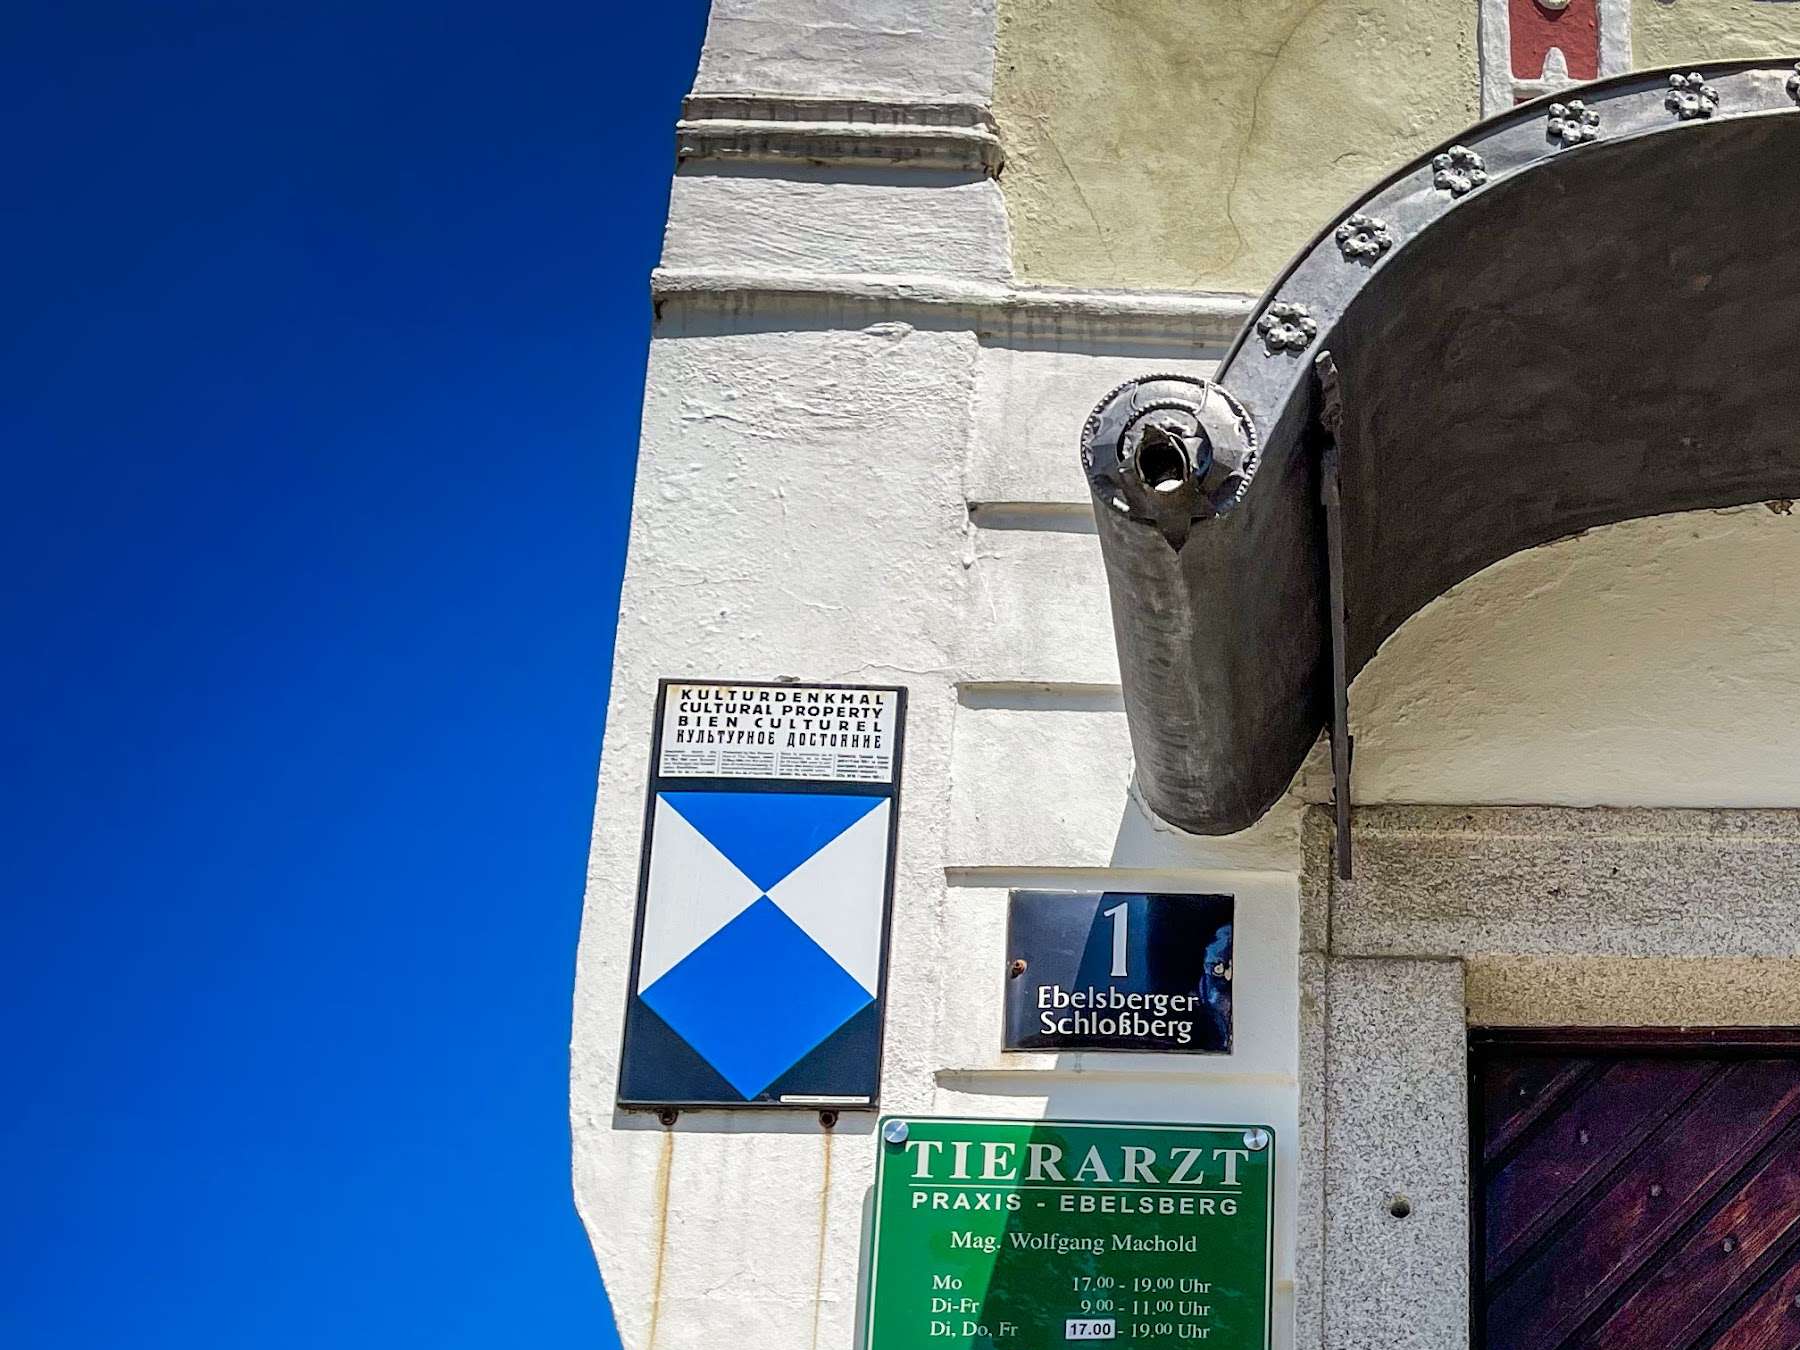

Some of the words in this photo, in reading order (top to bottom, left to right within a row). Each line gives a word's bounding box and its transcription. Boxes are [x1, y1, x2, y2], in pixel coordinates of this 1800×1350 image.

[681, 689, 884, 705] KULTURDENKMAL
[680, 703, 773, 715] CULTURAL
[782, 706, 883, 719] PROPERTY
[678, 716, 738, 727] BIEN
[754, 718, 882, 732] CULTUREL
[677, 730, 776, 745] КУЛЬТУРНОЕ
[786, 733, 882, 748] ДОСТОЯНИЕ
[1103, 902, 1128, 977] 1
[1038, 985, 1199, 1016] Ebelsberger
[1040, 1011, 1193, 1043] Schloßberg
[906, 1140, 1249, 1186] TIERARZT
[912, 1191, 1022, 1211] PRAXIS
[1059, 1195, 1238, 1215] EBELSBERG
[950, 1231, 1001, 1253] Mag.
[1011, 1233, 1105, 1254] Wolfgang
[1112, 1235, 1197, 1252] Machold
[933, 1275, 962, 1290] Mo
[1073, 1276, 1114, 1293] 17.00
[1133, 1278, 1174, 1293] 19.00
[1179, 1279, 1212, 1294] Uhr
[931, 1298, 980, 1314] Di-Fr
[1081, 1300, 1114, 1315] 9.00
[1133, 1301, 1173, 1316] 11.00
[1179, 1302, 1211, 1317] Uhr
[930, 1321, 957, 1339] Di,
[962, 1322, 993, 1339] Do,
[999, 1323, 1018, 1337] Fr
[1070, 1323, 1111, 1336] 17.00
[1132, 1323, 1172, 1338] 19.00
[1178, 1324, 1210, 1339] Uhr
